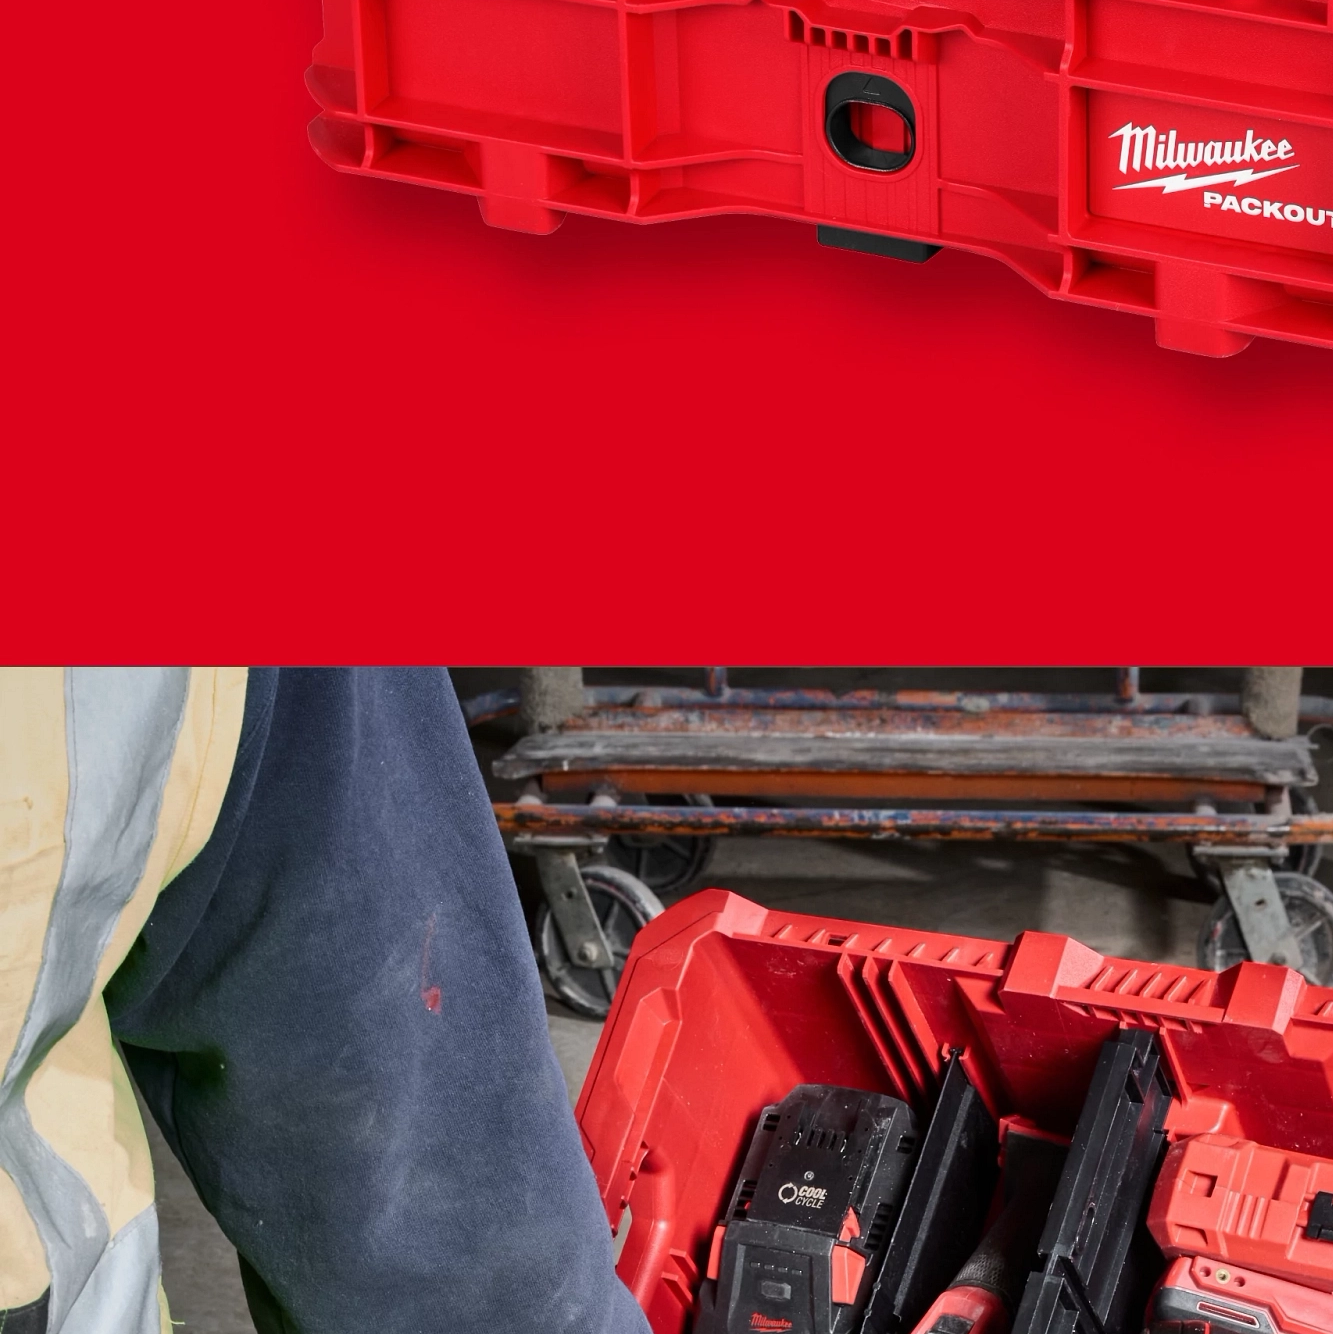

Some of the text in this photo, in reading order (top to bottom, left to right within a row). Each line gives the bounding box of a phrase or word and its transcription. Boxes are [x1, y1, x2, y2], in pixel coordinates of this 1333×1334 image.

[1108, 122, 1295, 174] Milwaukee
[798, 1185, 828, 1200] COOL
[795, 1196, 825, 1209] CYCLE
[750, 1311, 793, 1329] Milwaukee
